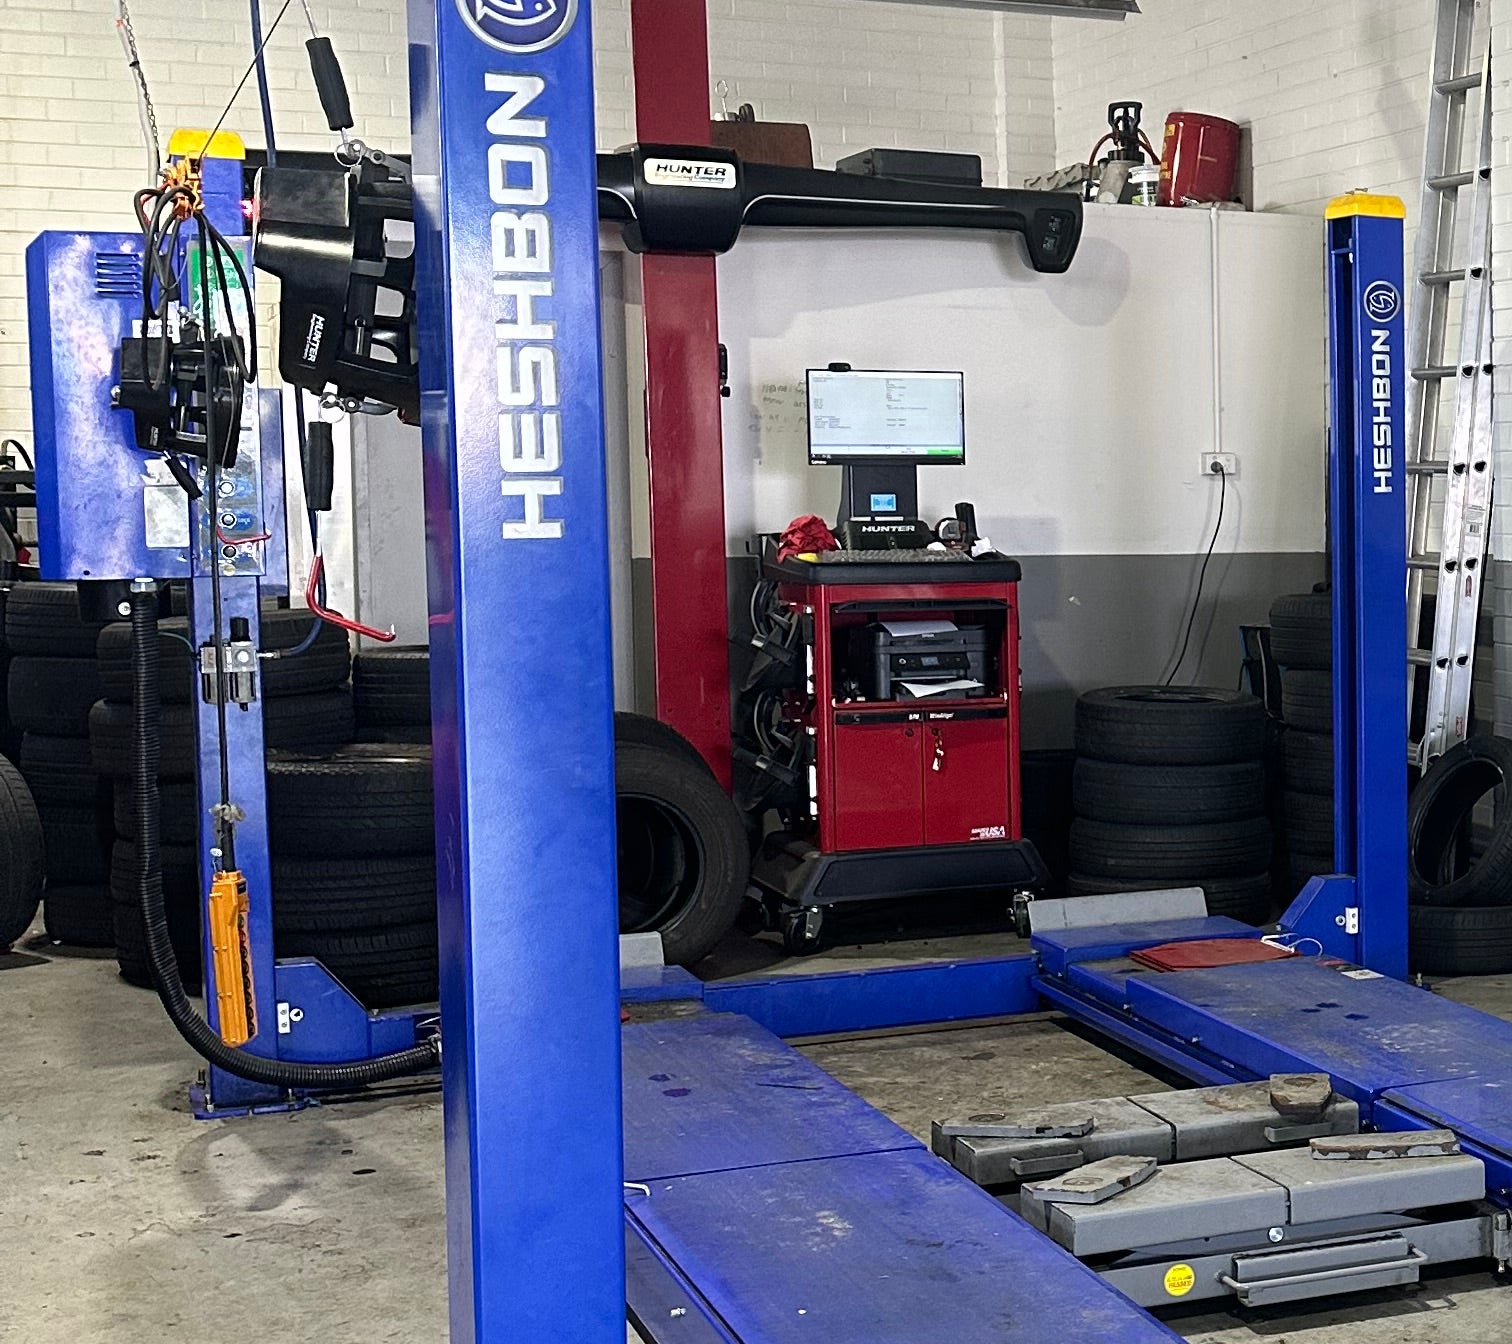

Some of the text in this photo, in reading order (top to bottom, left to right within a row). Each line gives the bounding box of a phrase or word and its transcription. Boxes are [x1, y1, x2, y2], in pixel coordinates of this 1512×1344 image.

[656, 163, 727, 176] HUNTER
[484, 71, 565, 540] HESHBON
[307, 314, 326, 363] HUNTER
[1371, 329, 1393, 494] HESHBON
[861, 524, 916, 533] HUNTER
